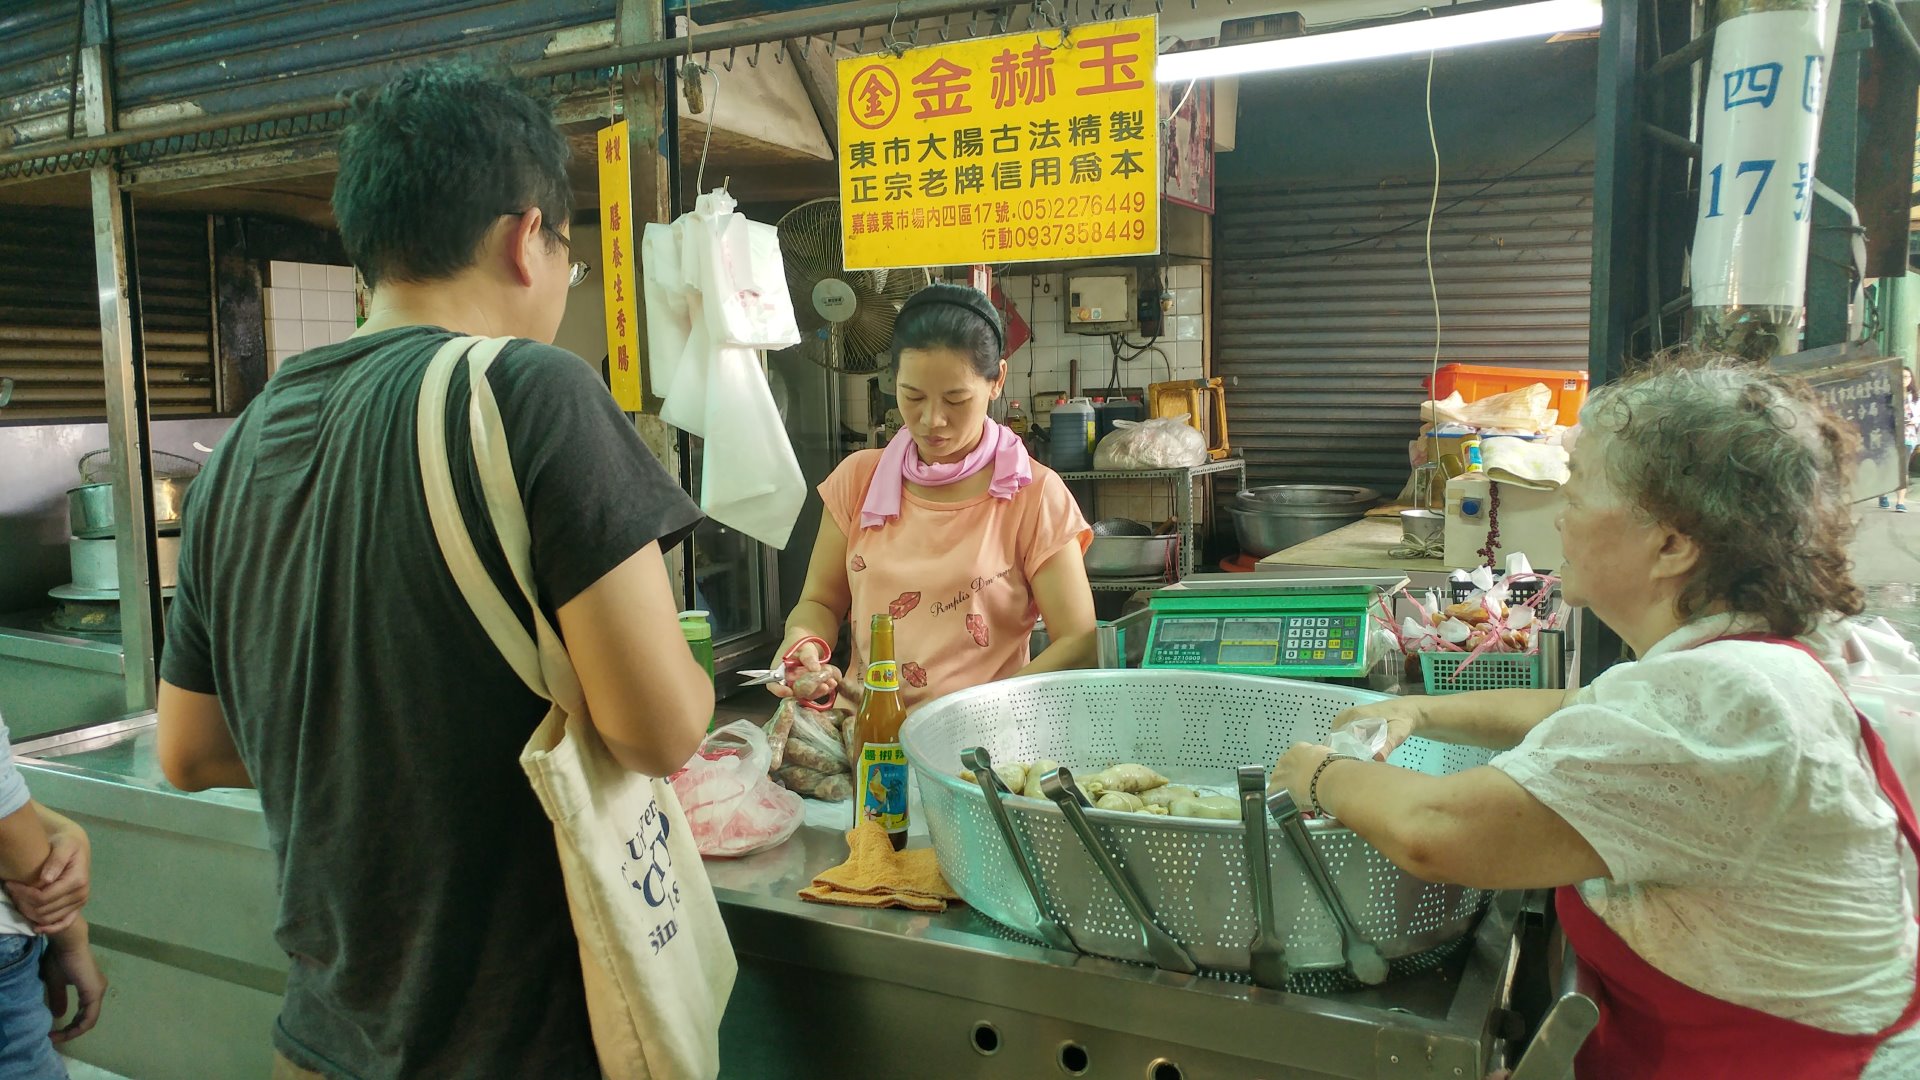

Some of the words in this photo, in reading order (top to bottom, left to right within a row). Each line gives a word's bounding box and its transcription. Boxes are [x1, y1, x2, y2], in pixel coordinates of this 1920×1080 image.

[911, 32, 1145, 120] 金赫玉
[848, 109, 1145, 170] 東市大腸古法精製
[981, 219, 1146, 251] 行動0937358449
